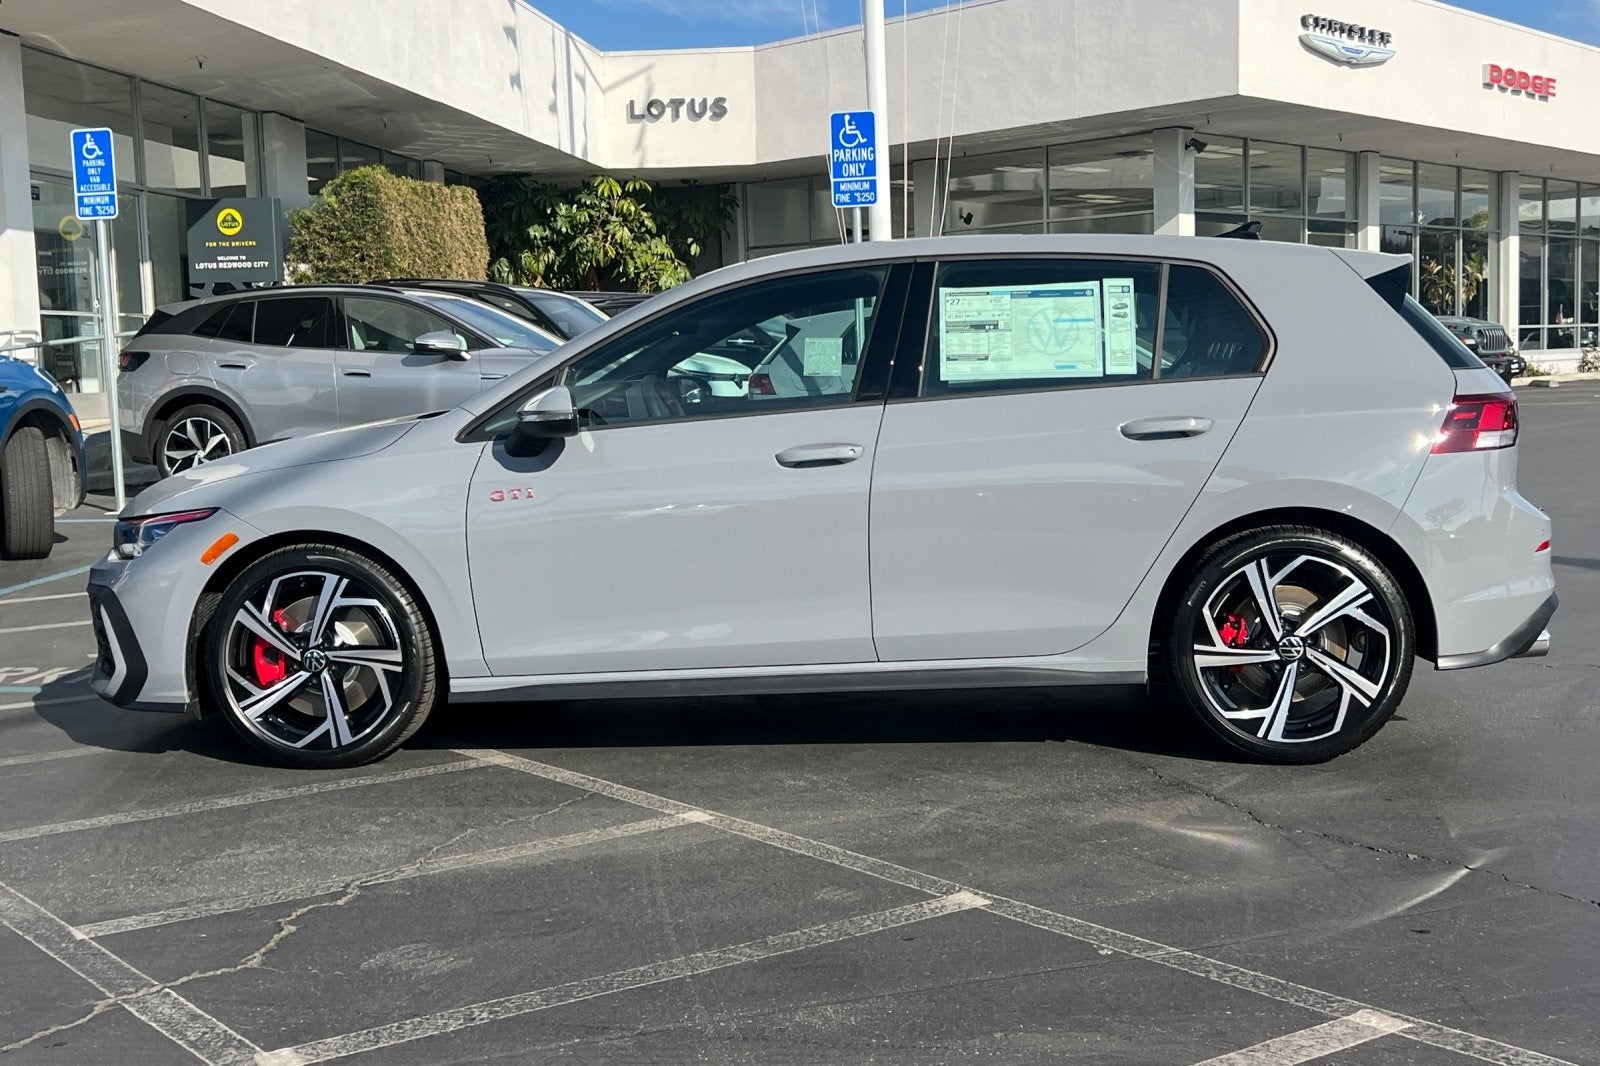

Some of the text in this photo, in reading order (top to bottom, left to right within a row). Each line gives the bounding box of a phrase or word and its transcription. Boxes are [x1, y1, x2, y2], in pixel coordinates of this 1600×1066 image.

[1301, 14, 1391, 46] CHRYSLER
[1485, 64, 1556, 98] DODGE
[628, 97, 728, 121] LOTUS
[833, 147, 874, 162] PARKING
[82, 159, 106, 167] PARKING
[87, 168, 102, 176] ONLY
[842, 163, 866, 177] ONLY
[80, 183, 111, 192] ACCESSIBLE
[839, 181, 870, 191] MINIMUM
[83, 196, 110, 205] MINIMUM
[835, 192, 875, 203] FINE $250
[80, 206, 93, 216] FINE
[218, 261, 252, 269] REDWOOD
[489, 487, 535, 502] GTI
